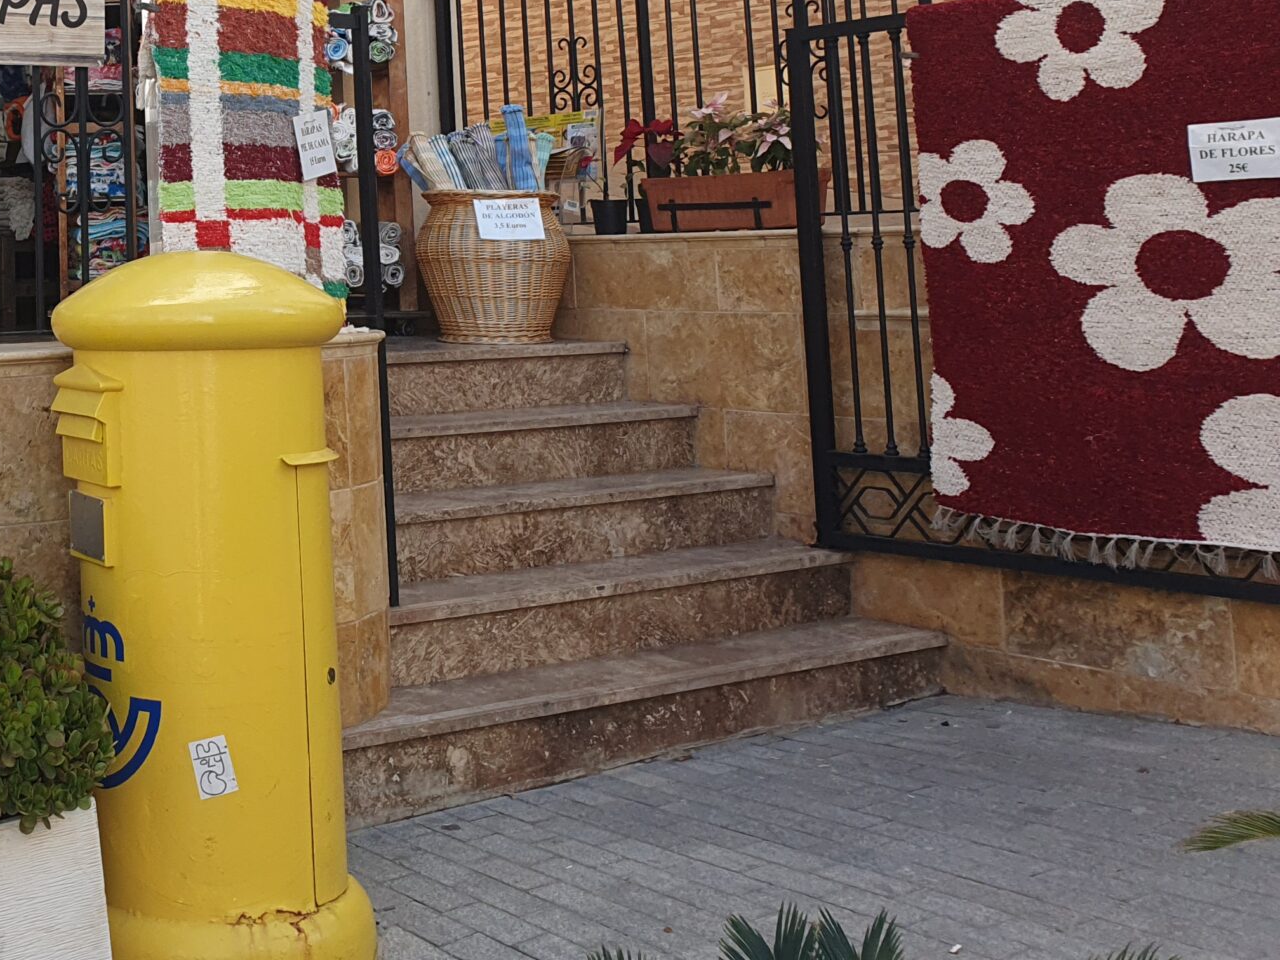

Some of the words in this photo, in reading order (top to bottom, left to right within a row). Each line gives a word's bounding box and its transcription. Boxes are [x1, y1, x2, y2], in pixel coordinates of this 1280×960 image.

[1207, 130, 1265, 143] HARAPA
[1199, 149, 1217, 159] DE
[1221, 145, 1276, 158] FLORES
[1229, 163, 1248, 173] 25€
[486, 203, 529, 211] PLAYERAS
